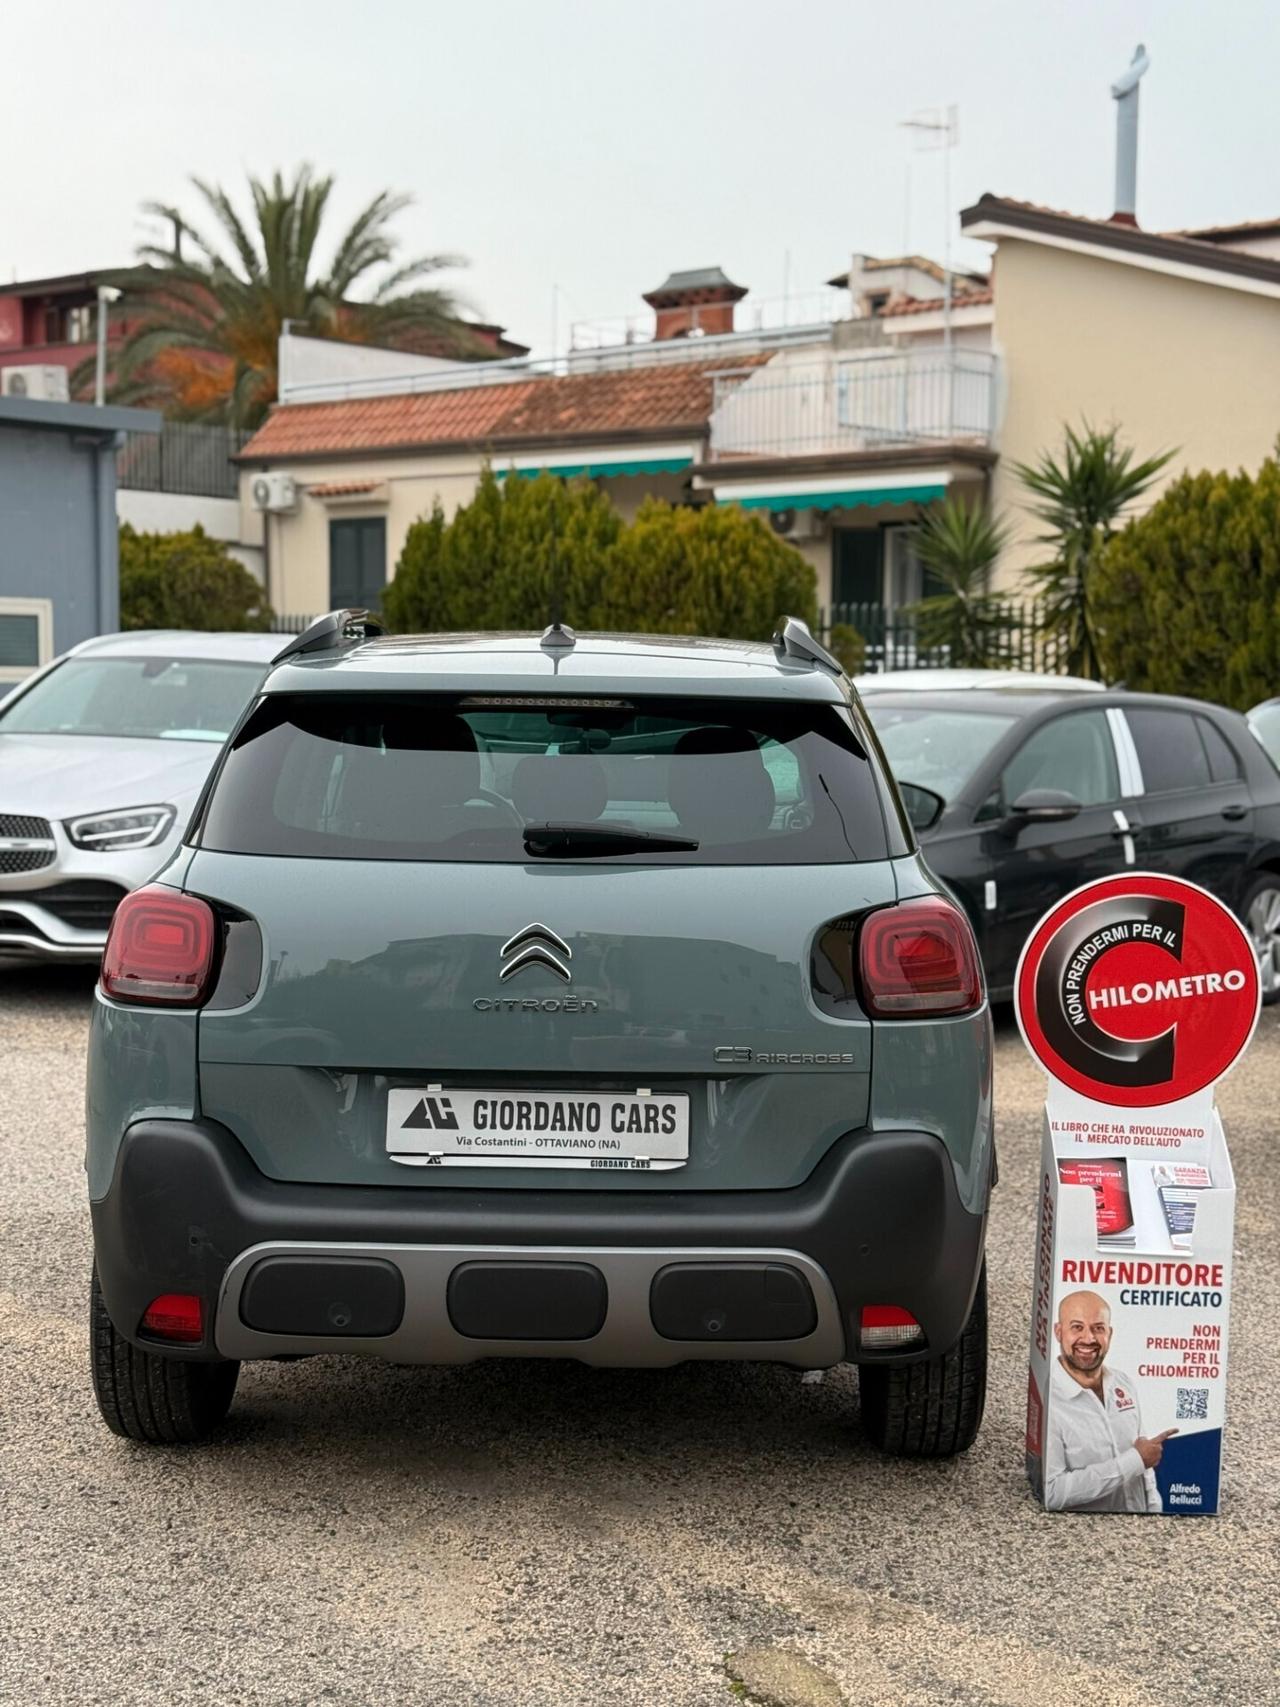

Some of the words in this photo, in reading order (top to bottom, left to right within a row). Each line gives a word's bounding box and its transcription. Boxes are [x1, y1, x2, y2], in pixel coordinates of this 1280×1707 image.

[1133, 923, 1161, 940] PER
[1164, 930, 1177, 948] IL
[1066, 925, 1129, 990] PRENDERMI
[472, 994, 600, 1013] CITROËN
[1066, 994, 1086, 1026] NON
[712, 1045, 753, 1064] C3
[756, 1053, 855, 1065] AIRCROSS
[472, 1099, 602, 1133] GIORDANO
[610, 1102, 677, 1135] CARS
[1051, 1122, 1060, 1131] IL
[1061, 1122, 1089, 1132] LIBRO
[1091, 1123, 1110, 1133] CHE
[1111, 1124, 1125, 1134] HA
[1129, 1125, 1204, 1138] RIVOLUZIONATO
[456, 1136, 472, 1147] Via
[475, 1136, 528, 1148] Costantini
[535, 1138, 597, 1149] OTTAVIANO
[598, 1139, 621, 1151] (NA)
[1074, 1133, 1083, 1143] IL
[1087, 1134, 1131, 1145] MERCATO
[1133, 1136, 1182, 1148] DELL'AUTO
[590, 1160, 628, 1169] GIORDANO
[629, 1160, 651, 1169] CARS
[1039, 1173, 1050, 1283] CONTRO
[1042, 1192, 1053, 1310] INSIEME
[1062, 1260, 1224, 1287] RIVENDITORE
[1120, 1289, 1223, 1308] CERTIFICATO
[1035, 1289, 1044, 1350] NON
[1040, 1314, 1048, 1361] MA
[1192, 1324, 1221, 1338] NON
[1146, 1337, 1221, 1351] PRENDERMI
[1182, 1352, 1207, 1365] PER
[1209, 1353, 1220, 1365] IL
[1138, 1364, 1219, 1379] CHILOMETRO
[1169, 1483, 1201, 1494] Alfredo
[1169, 1495, 1202, 1505] Bellucci
